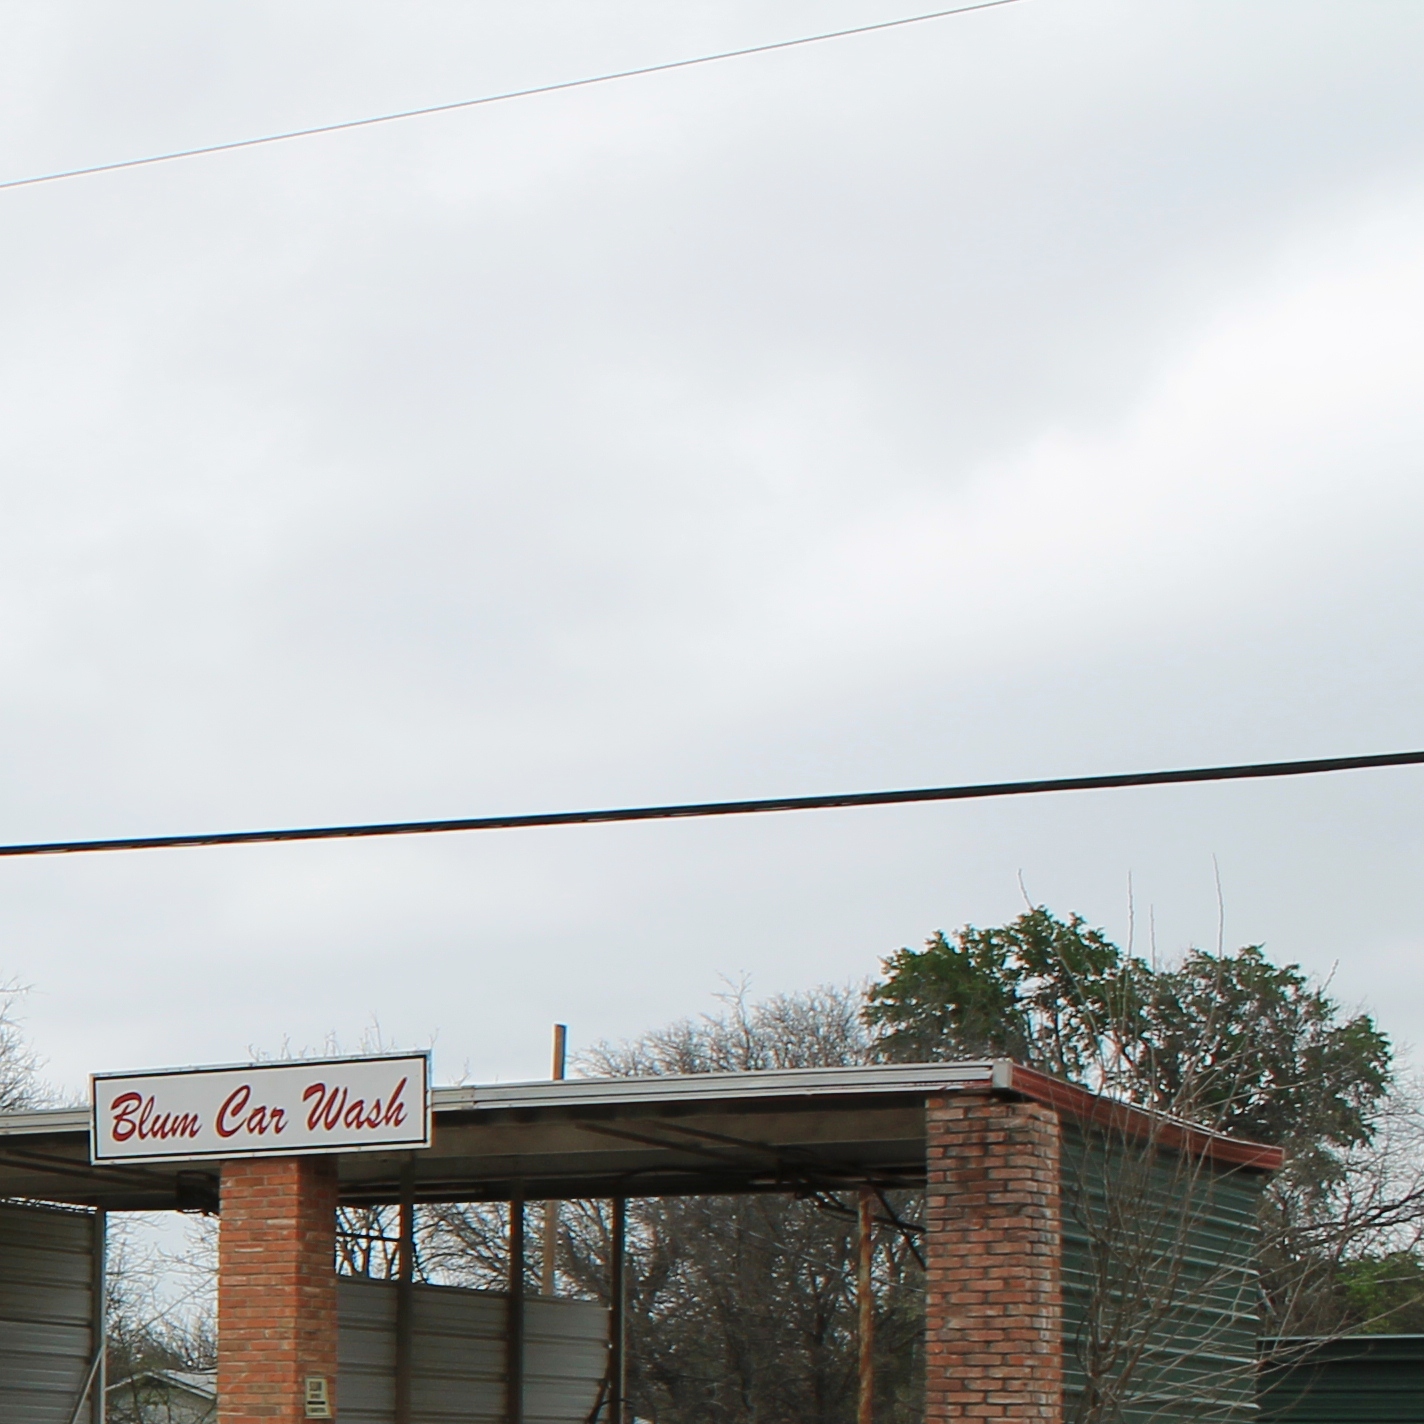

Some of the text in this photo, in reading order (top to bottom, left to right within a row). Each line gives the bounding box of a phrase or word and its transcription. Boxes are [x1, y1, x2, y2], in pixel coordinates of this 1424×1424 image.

[111, 1076, 409, 1142] Blum Car Wash
